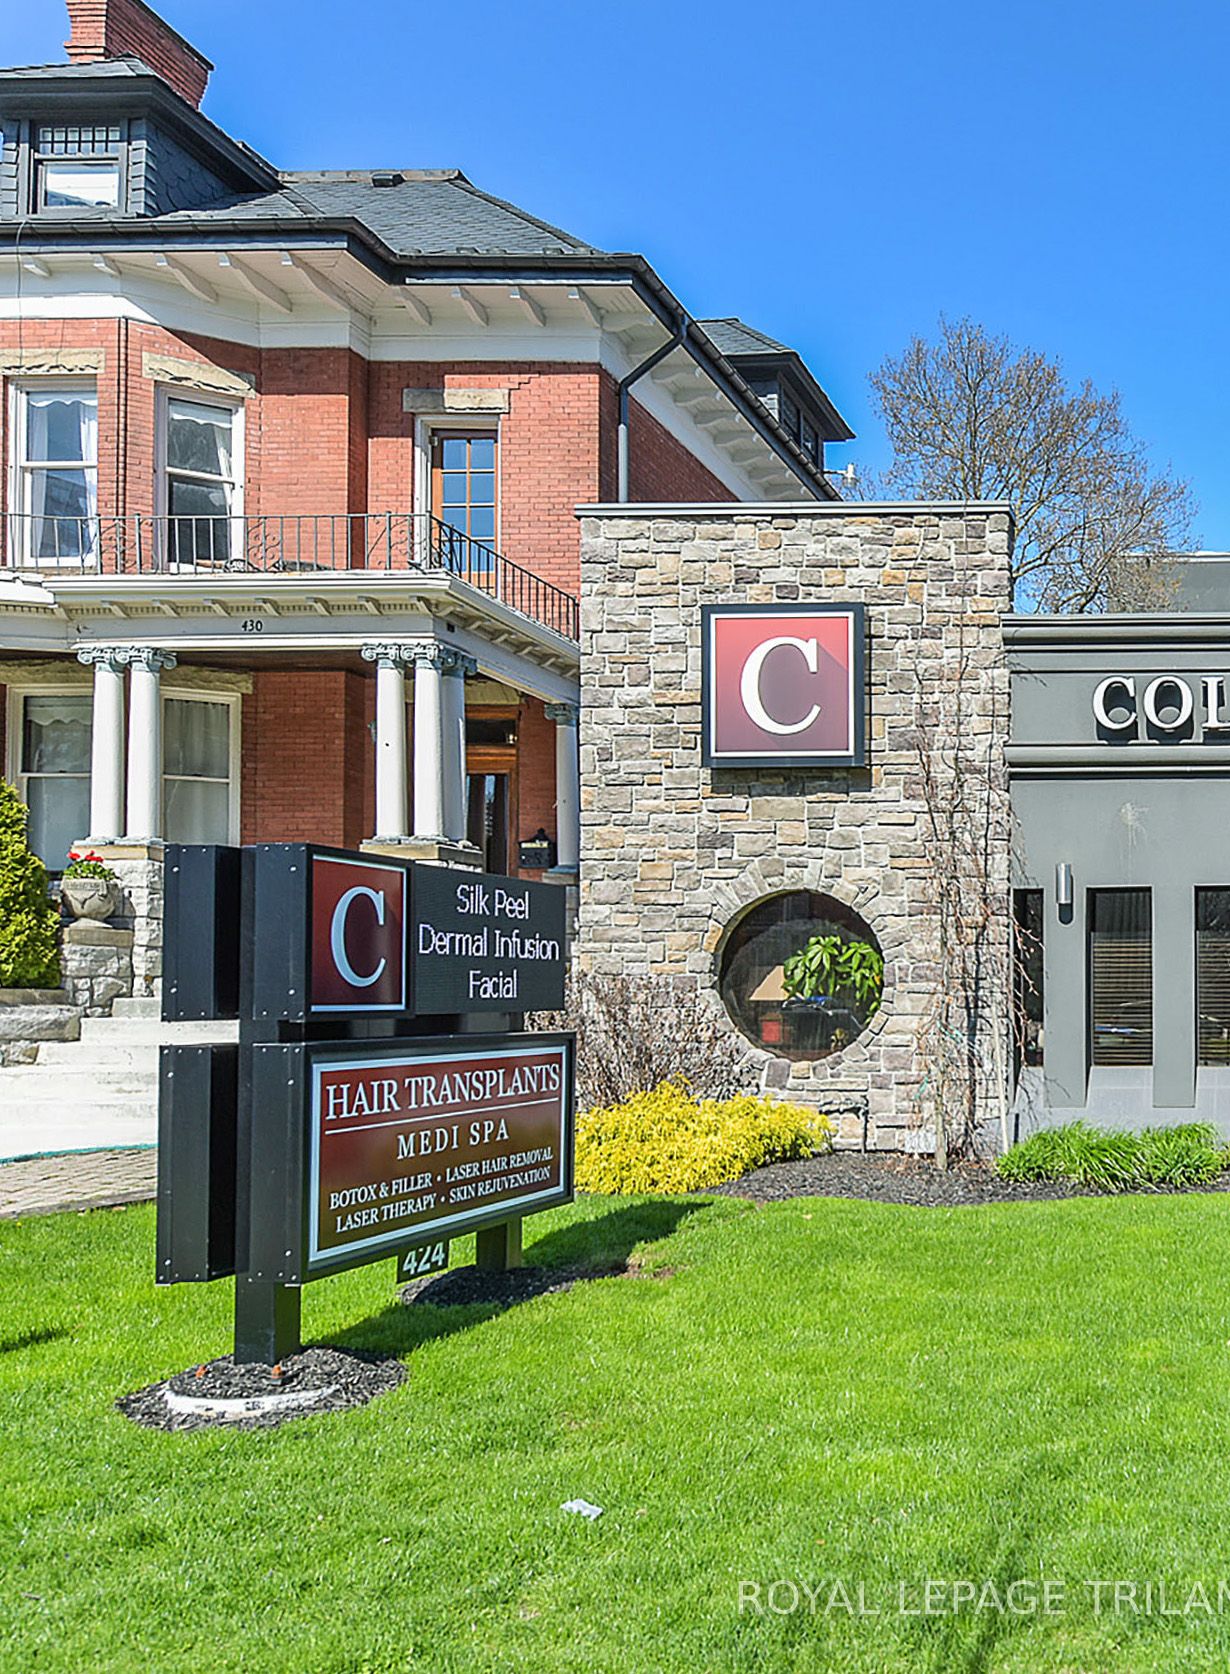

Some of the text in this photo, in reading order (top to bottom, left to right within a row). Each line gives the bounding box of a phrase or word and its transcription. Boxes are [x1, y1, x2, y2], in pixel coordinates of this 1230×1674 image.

[241, 619, 263, 632] 430
[740, 635, 822, 736] C
[456, 883, 529, 920] Silk Peel
[330, 885, 387, 988] C
[418, 922, 560, 961] Dermal Infusion
[468, 968, 518, 999] Facial
[324, 1063, 561, 1121] HAIR TRANSPLANTS
[396, 1118, 509, 1160] MEDI SPA
[329, 1146, 554, 1210] BOTOX & FILLER LASER HAIR REMOVAL
[335, 1165, 552, 1234] LASER THERAPY SKIN REJUVENATION
[402, 1241, 446, 1275] 424
